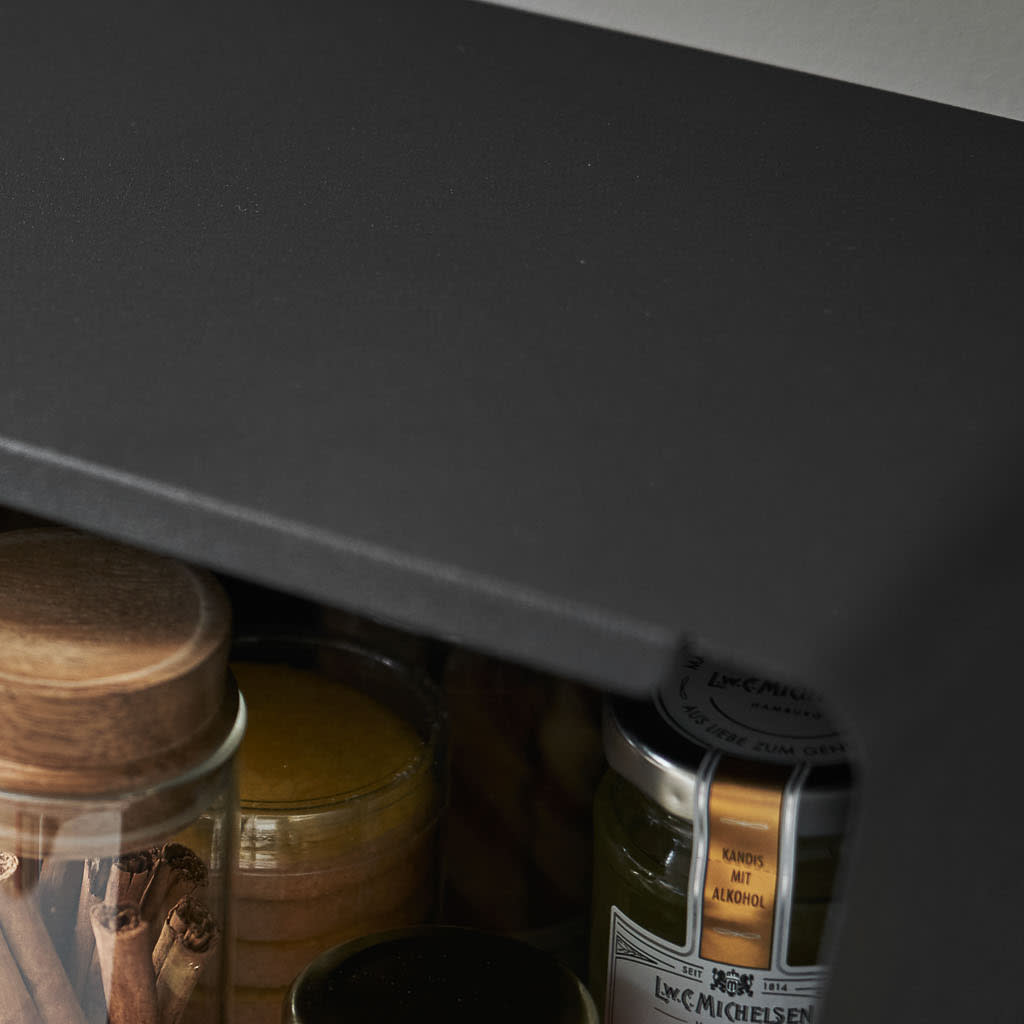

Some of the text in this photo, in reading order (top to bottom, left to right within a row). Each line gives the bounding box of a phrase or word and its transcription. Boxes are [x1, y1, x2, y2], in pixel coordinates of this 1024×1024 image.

[706, 723, 746, 746] LIEBE
[753, 742, 794, 755] ZUM
[722, 848, 764, 868] KANDIS
[730, 869, 751, 885] MIT
[712, 887, 765, 908] ALKOHOL
[682, 965, 788, 991] SEIT 1814
